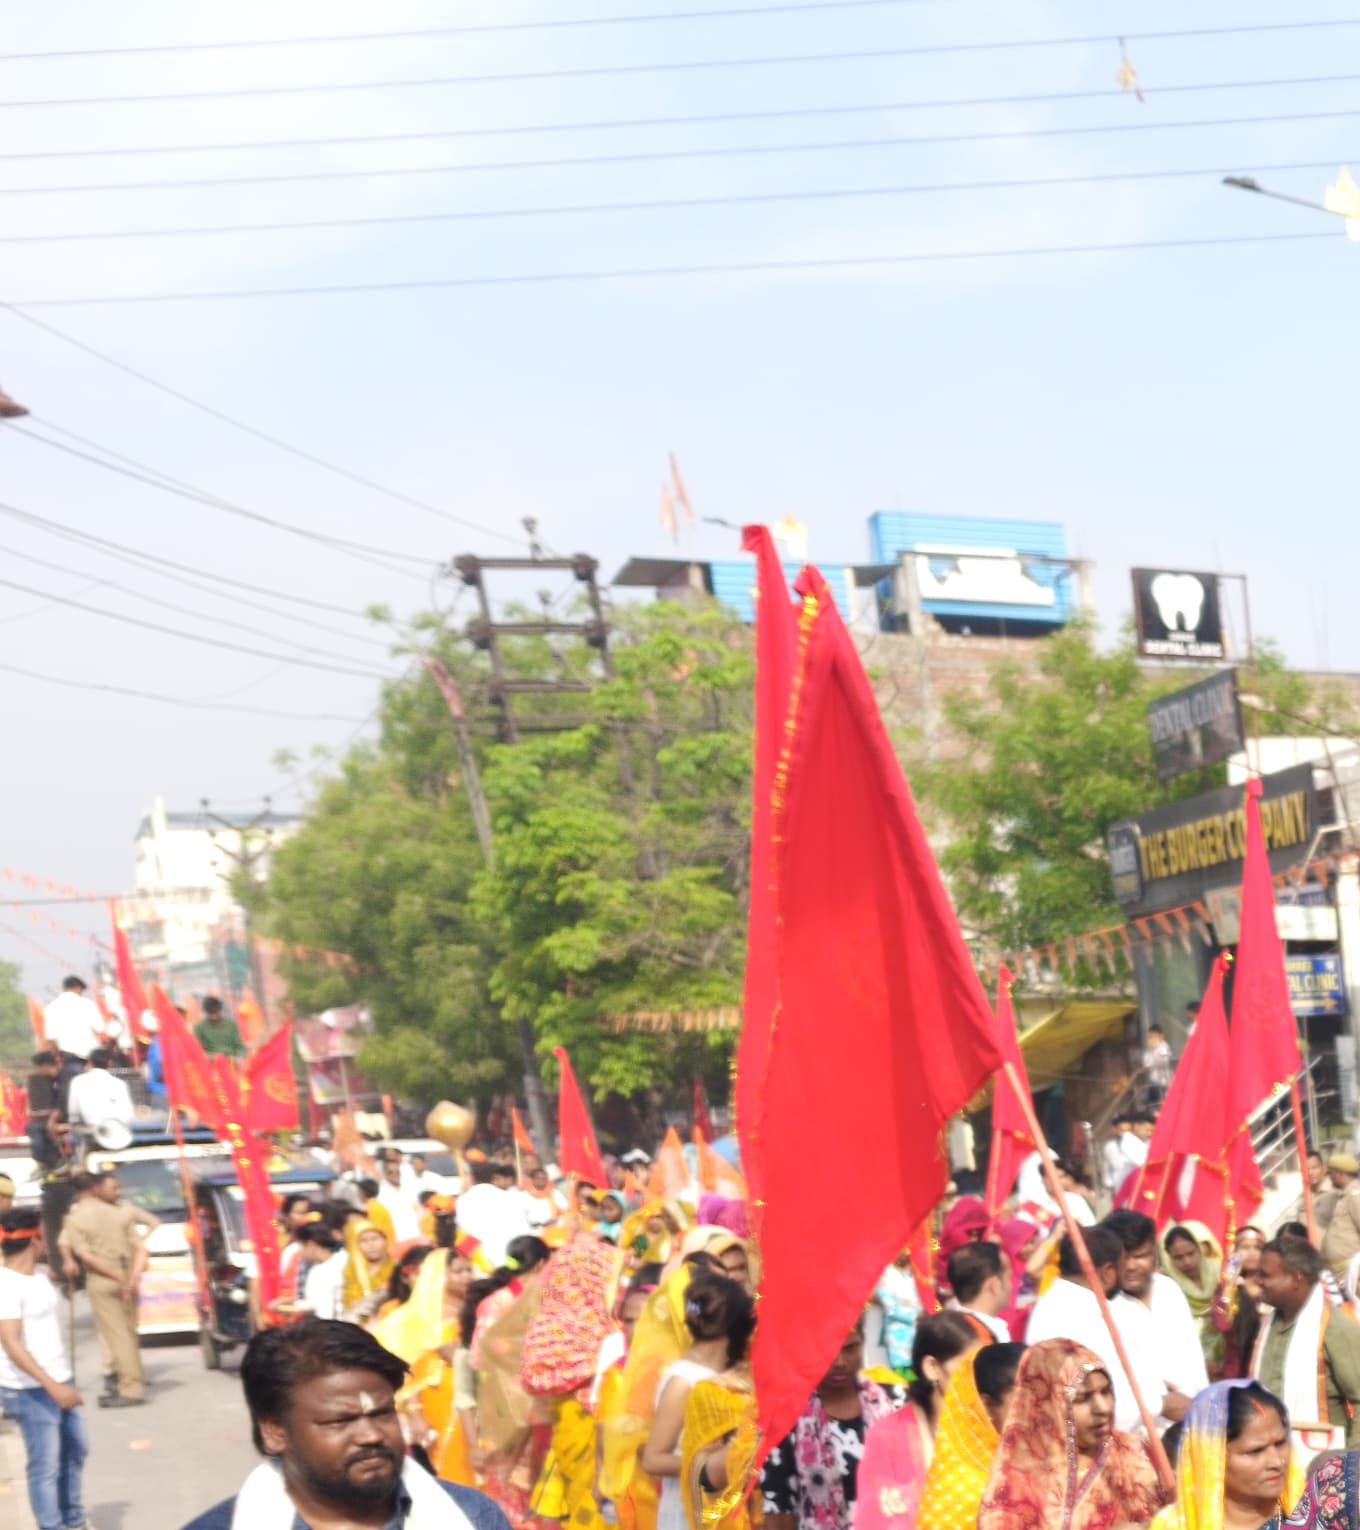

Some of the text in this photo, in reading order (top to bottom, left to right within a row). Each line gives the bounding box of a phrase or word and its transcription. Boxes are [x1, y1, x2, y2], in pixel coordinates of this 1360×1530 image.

[1141, 831, 1168, 881] THE
[1166, 814, 1228, 875] BURGER
[1225, 789, 1307, 860] COPANY
[1304, 974, 1338, 990] CLINIC
